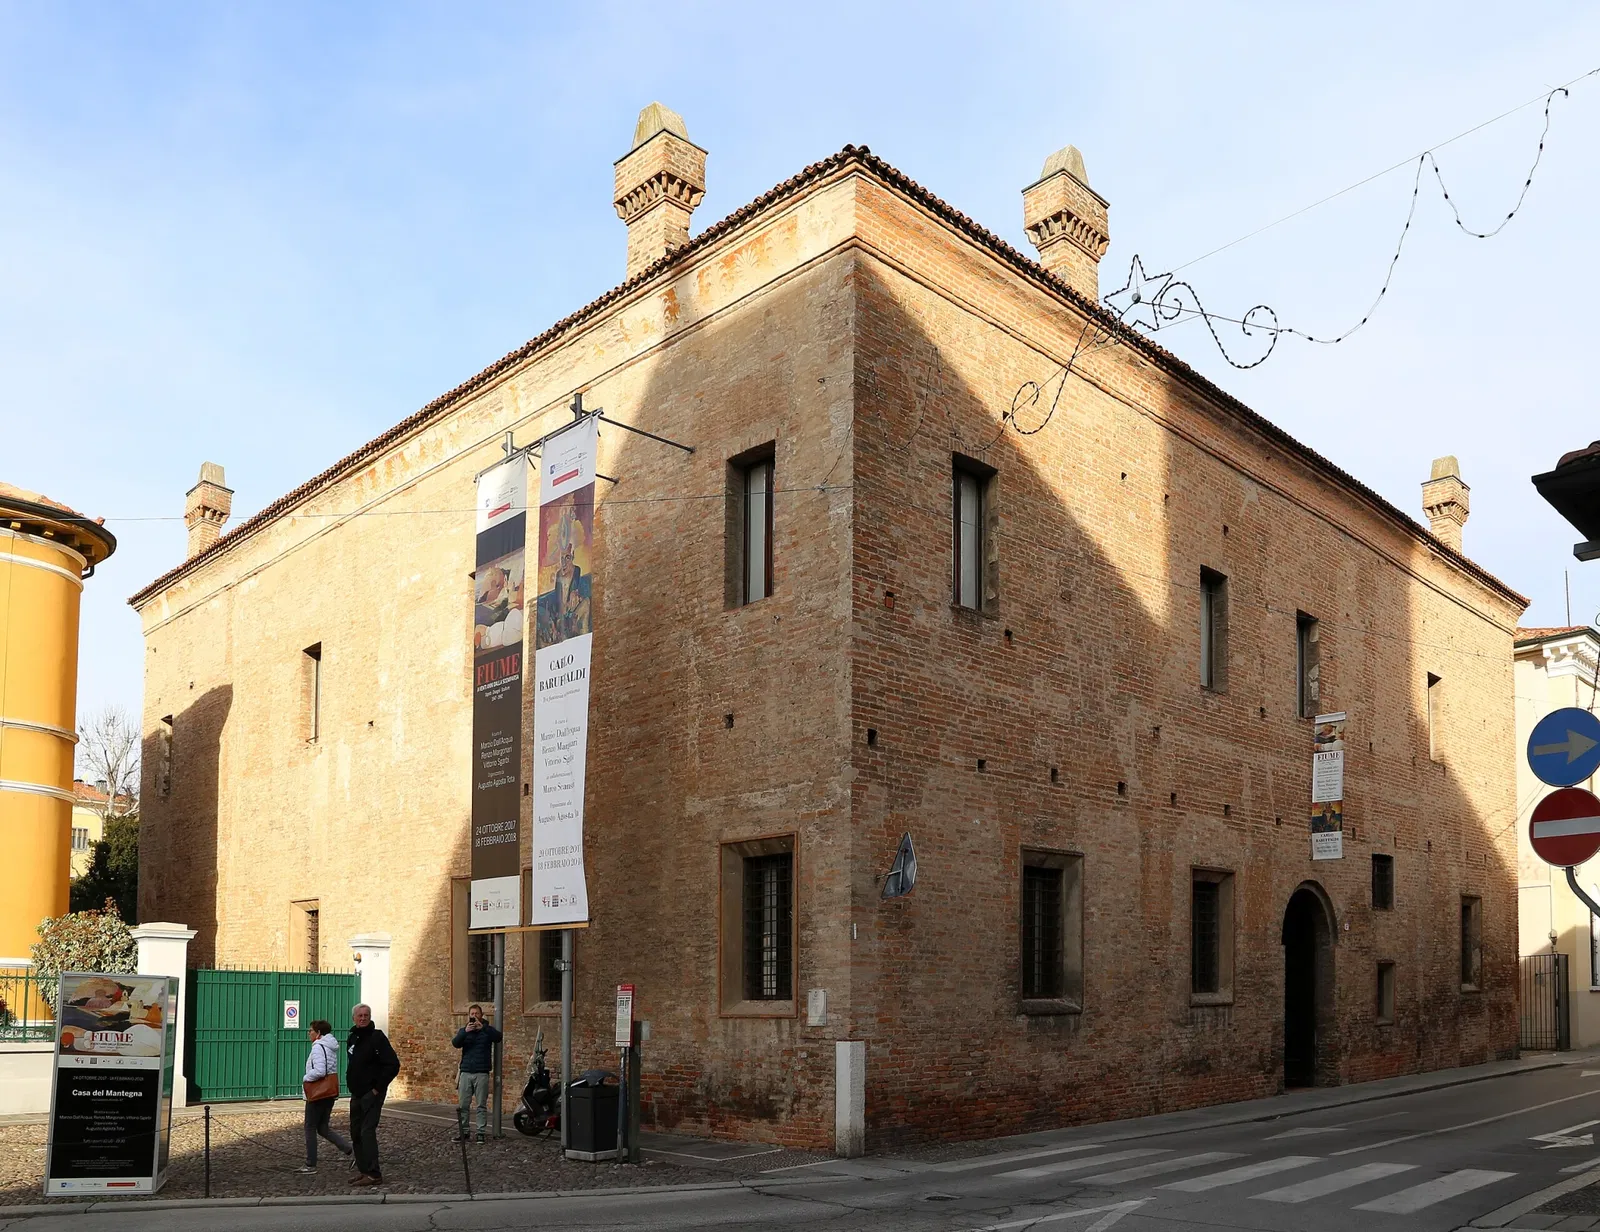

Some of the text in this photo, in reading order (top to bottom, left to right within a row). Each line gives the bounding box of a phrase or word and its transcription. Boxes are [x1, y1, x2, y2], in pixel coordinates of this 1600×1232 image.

[477, 653, 520, 686] FIUME
[1317, 752, 1340, 761] FIUME
[476, 820, 517, 836] 24 OTTOBRE 2017
[481, 834, 504, 847] FEBBRAIO
[504, 832, 517, 843] 2018
[545, 845, 568, 857] OTTOBRE
[544, 859, 567, 870] FEBBRAIO
[91, 1032, 134, 1043] FIUME
[105, 1090, 143, 1098] Mantegna
